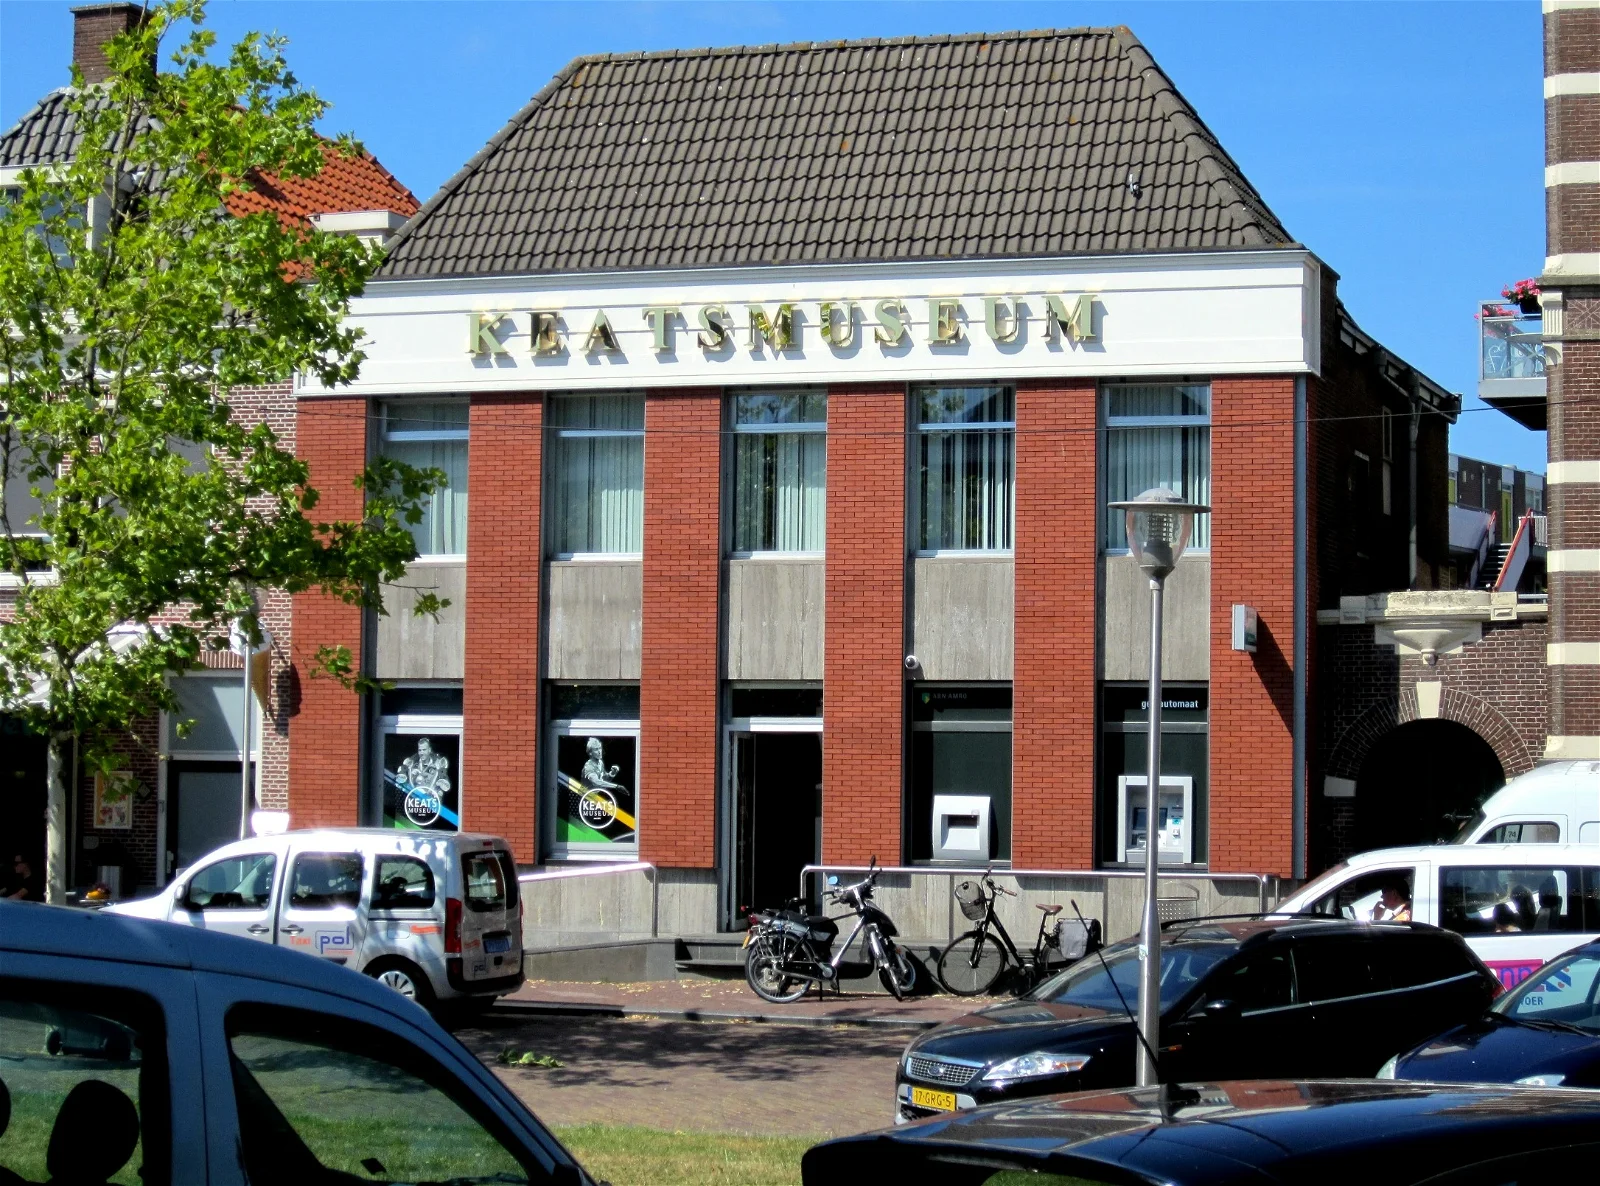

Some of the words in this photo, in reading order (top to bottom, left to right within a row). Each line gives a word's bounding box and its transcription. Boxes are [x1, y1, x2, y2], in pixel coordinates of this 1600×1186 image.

[408, 798, 437, 808] KEATS
[582, 800, 613, 811] KEATS
[290, 936, 311, 945] Taxi
[320, 925, 350, 954] pol
